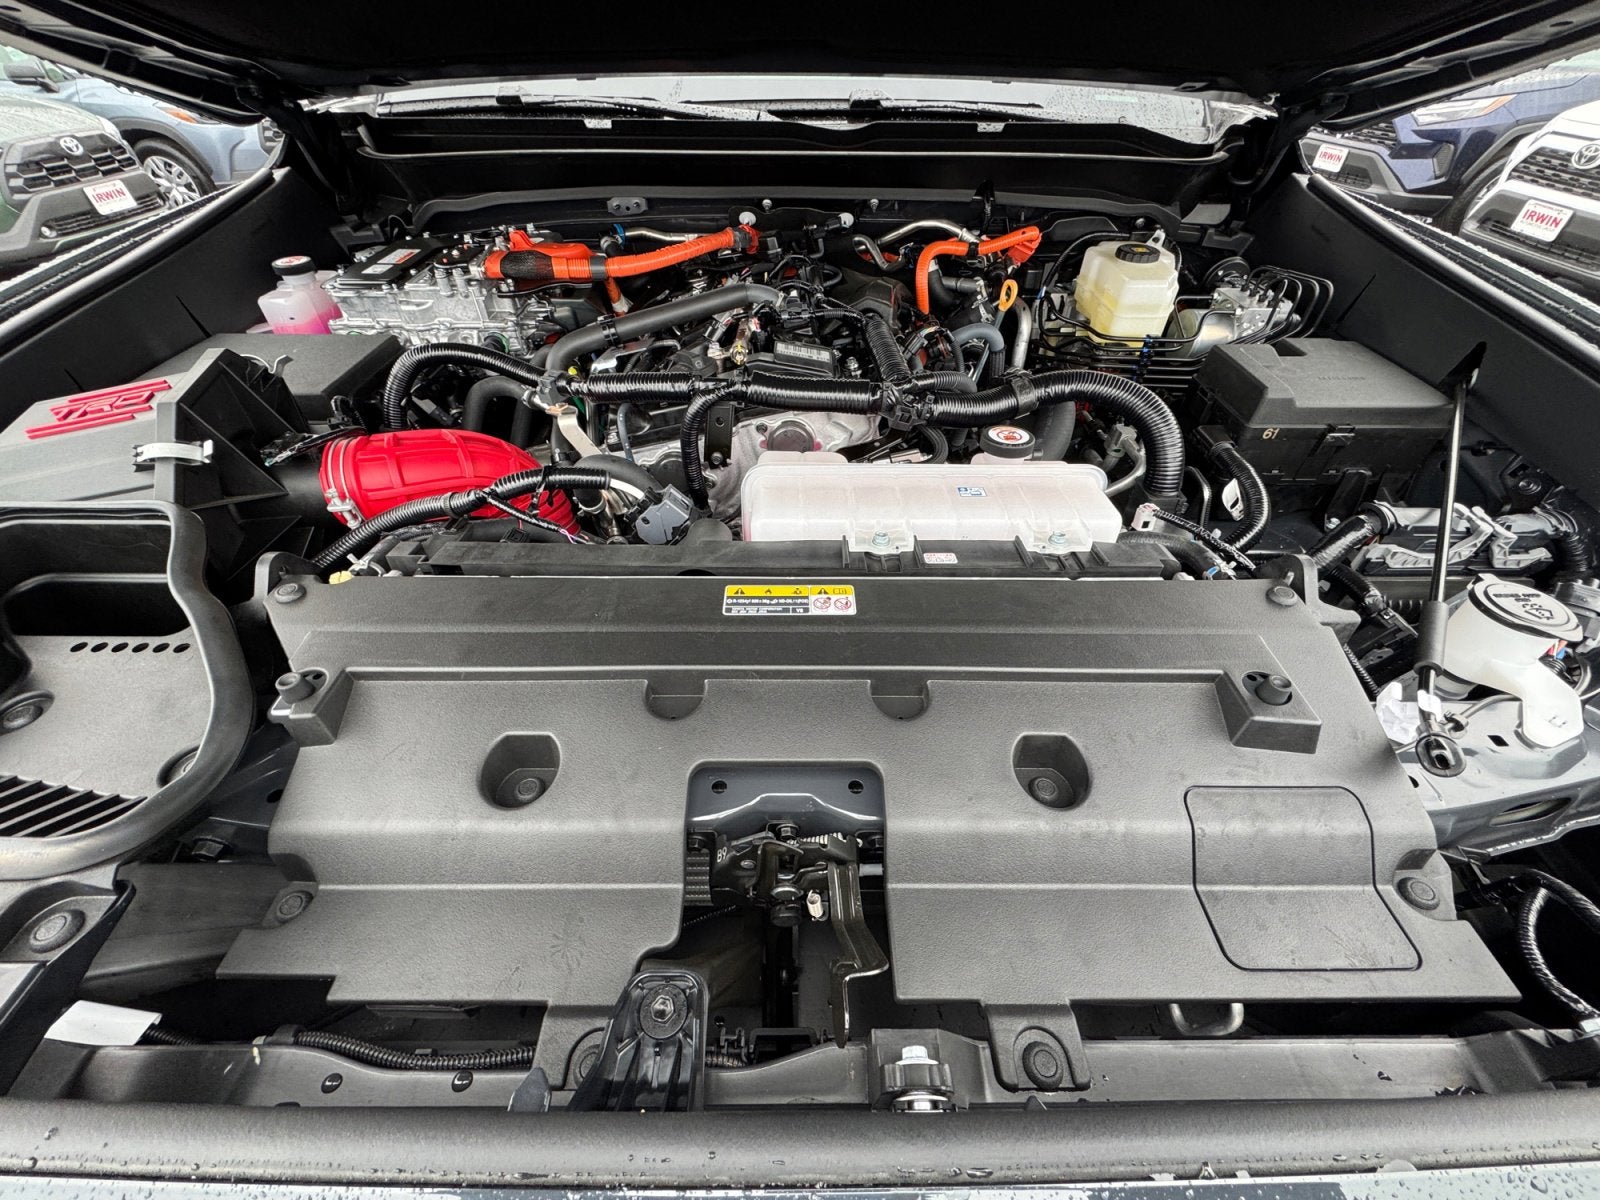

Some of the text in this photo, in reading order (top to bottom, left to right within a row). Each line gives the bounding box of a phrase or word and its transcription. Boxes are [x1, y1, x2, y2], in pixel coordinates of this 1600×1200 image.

[1319, 151, 1343, 162] IRWIN
[92, 187, 126, 203] IRWIN
[1522, 209, 1563, 228] IRWIN
[50, 391, 155, 421] TRD
[1262, 427, 1280, 439] 61
